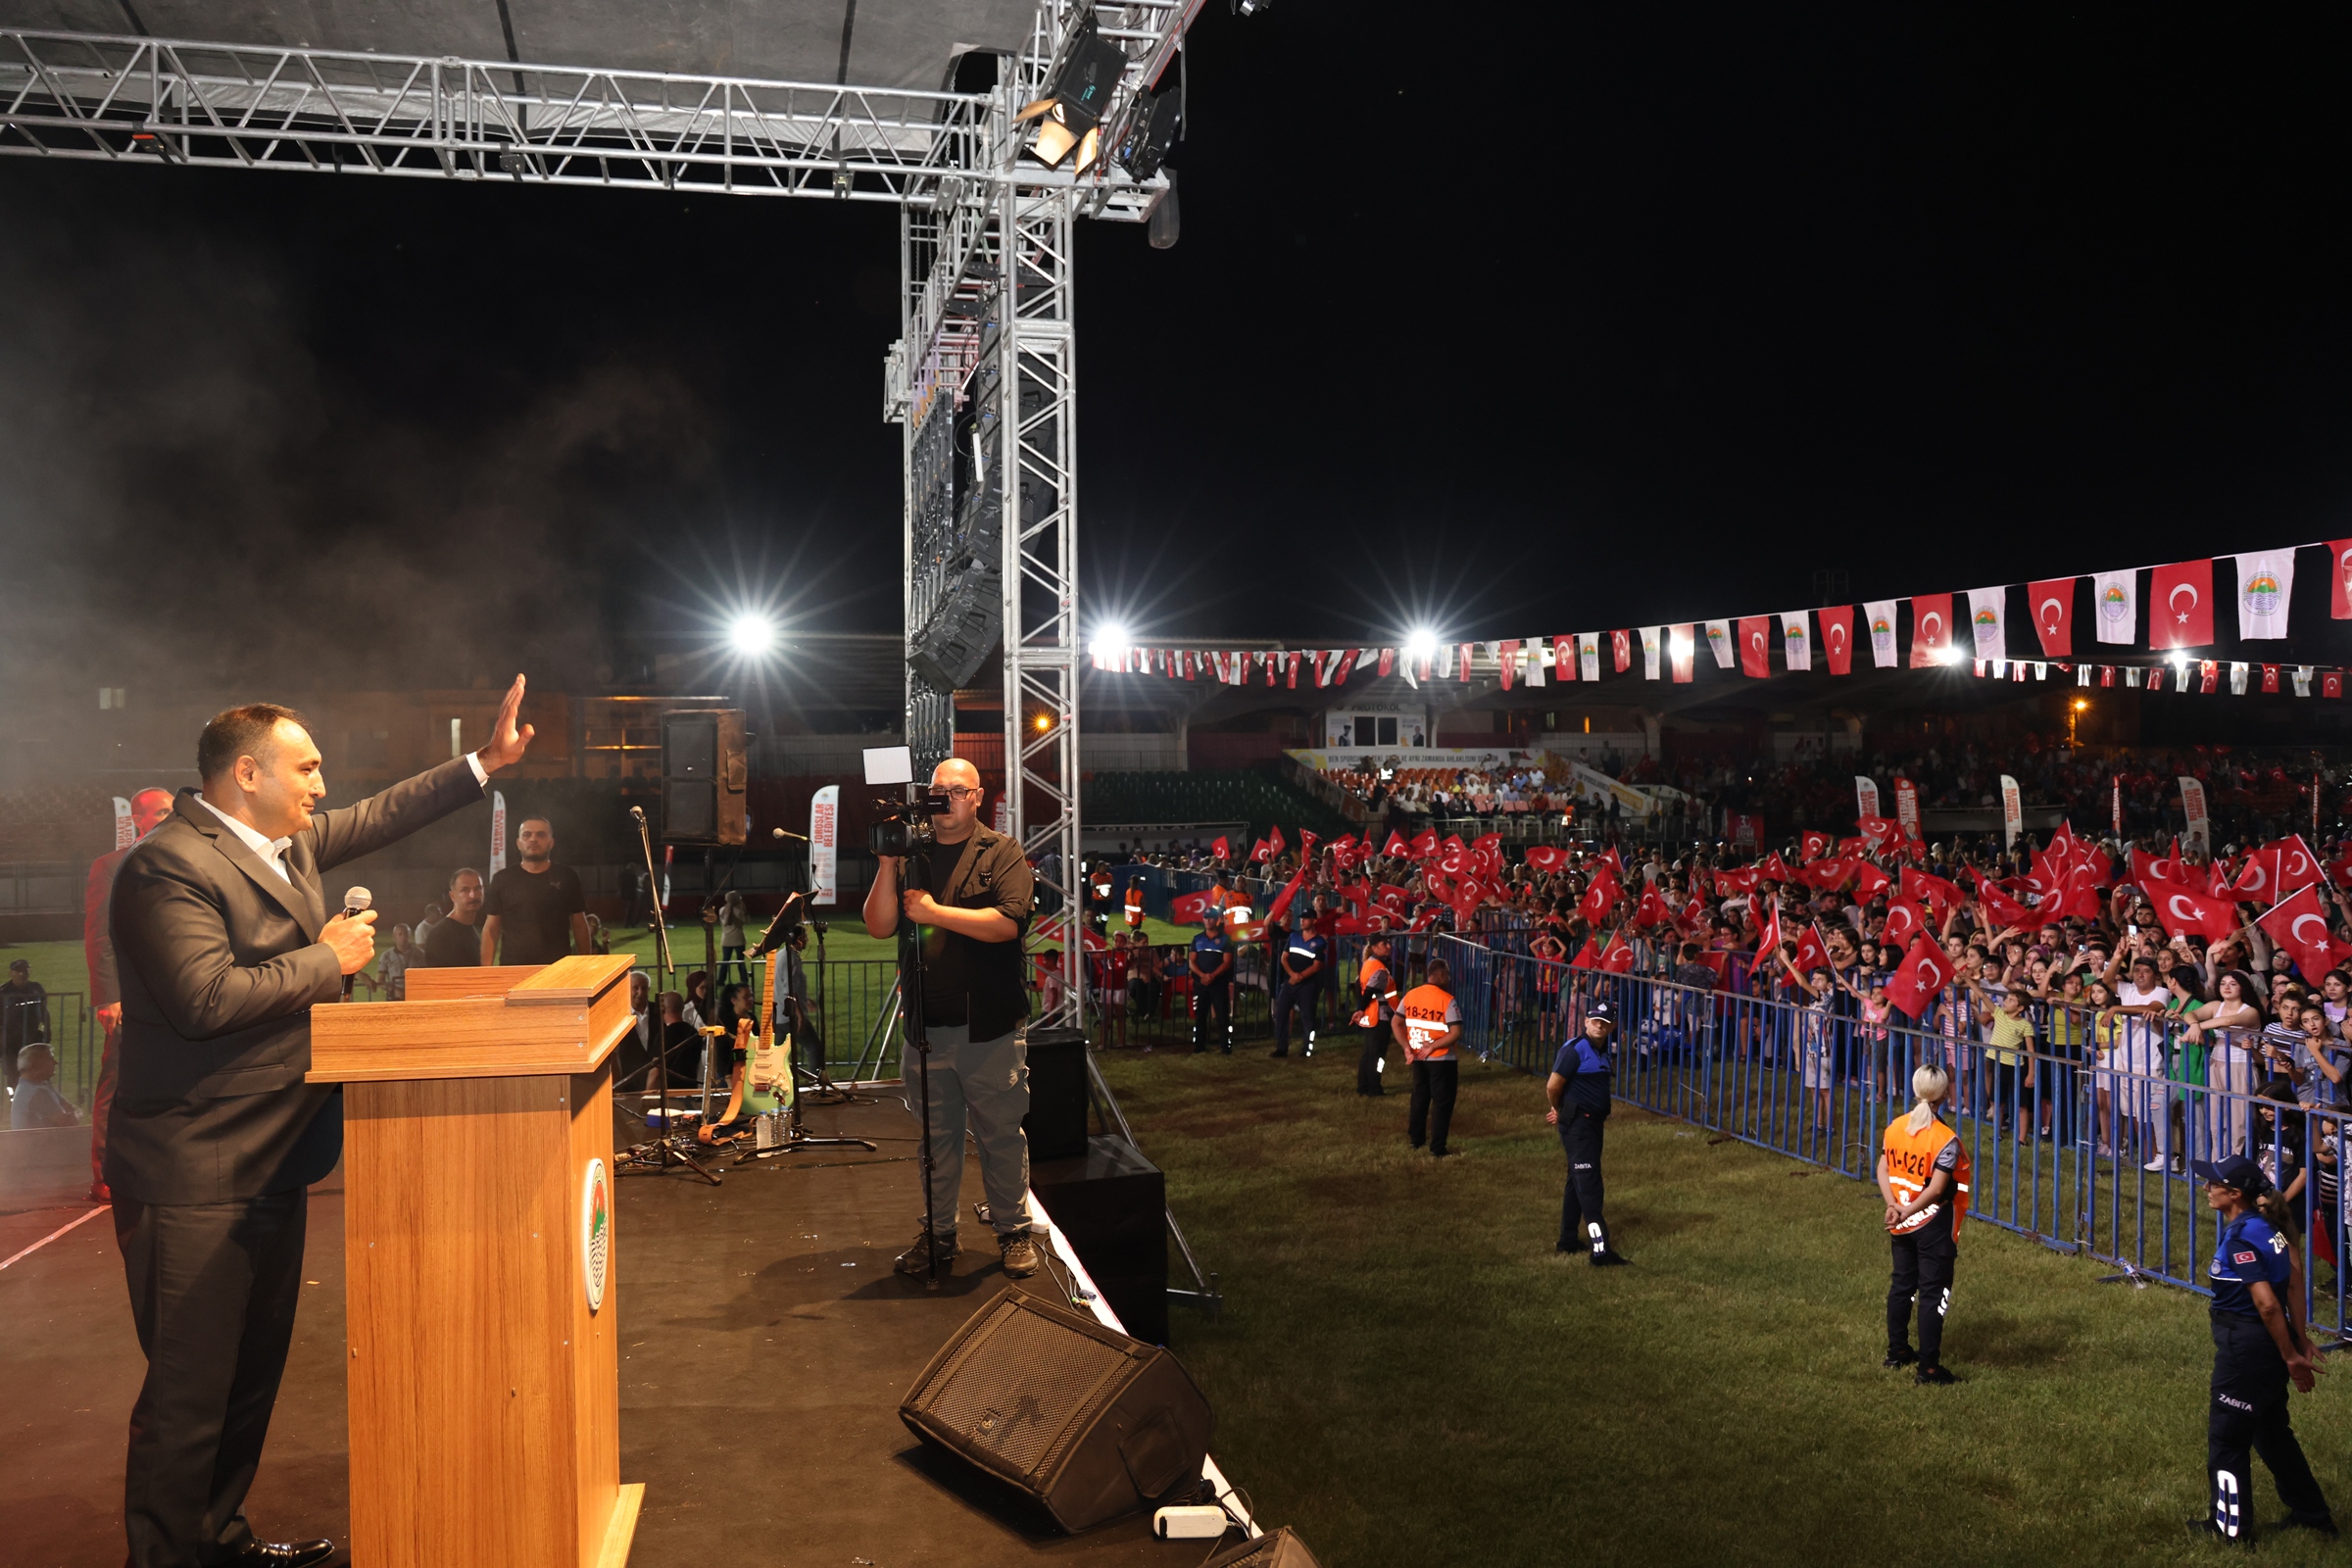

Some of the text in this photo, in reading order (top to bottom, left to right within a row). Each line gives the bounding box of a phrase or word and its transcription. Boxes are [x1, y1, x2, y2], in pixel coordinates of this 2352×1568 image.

[814, 803, 824, 844] TOROSLAR
[823, 804, 834, 848] BELEDİYESİ
[994, 802, 1006, 832] ROSLAR
[2218, 1393, 2253, 1412] ZABITA
